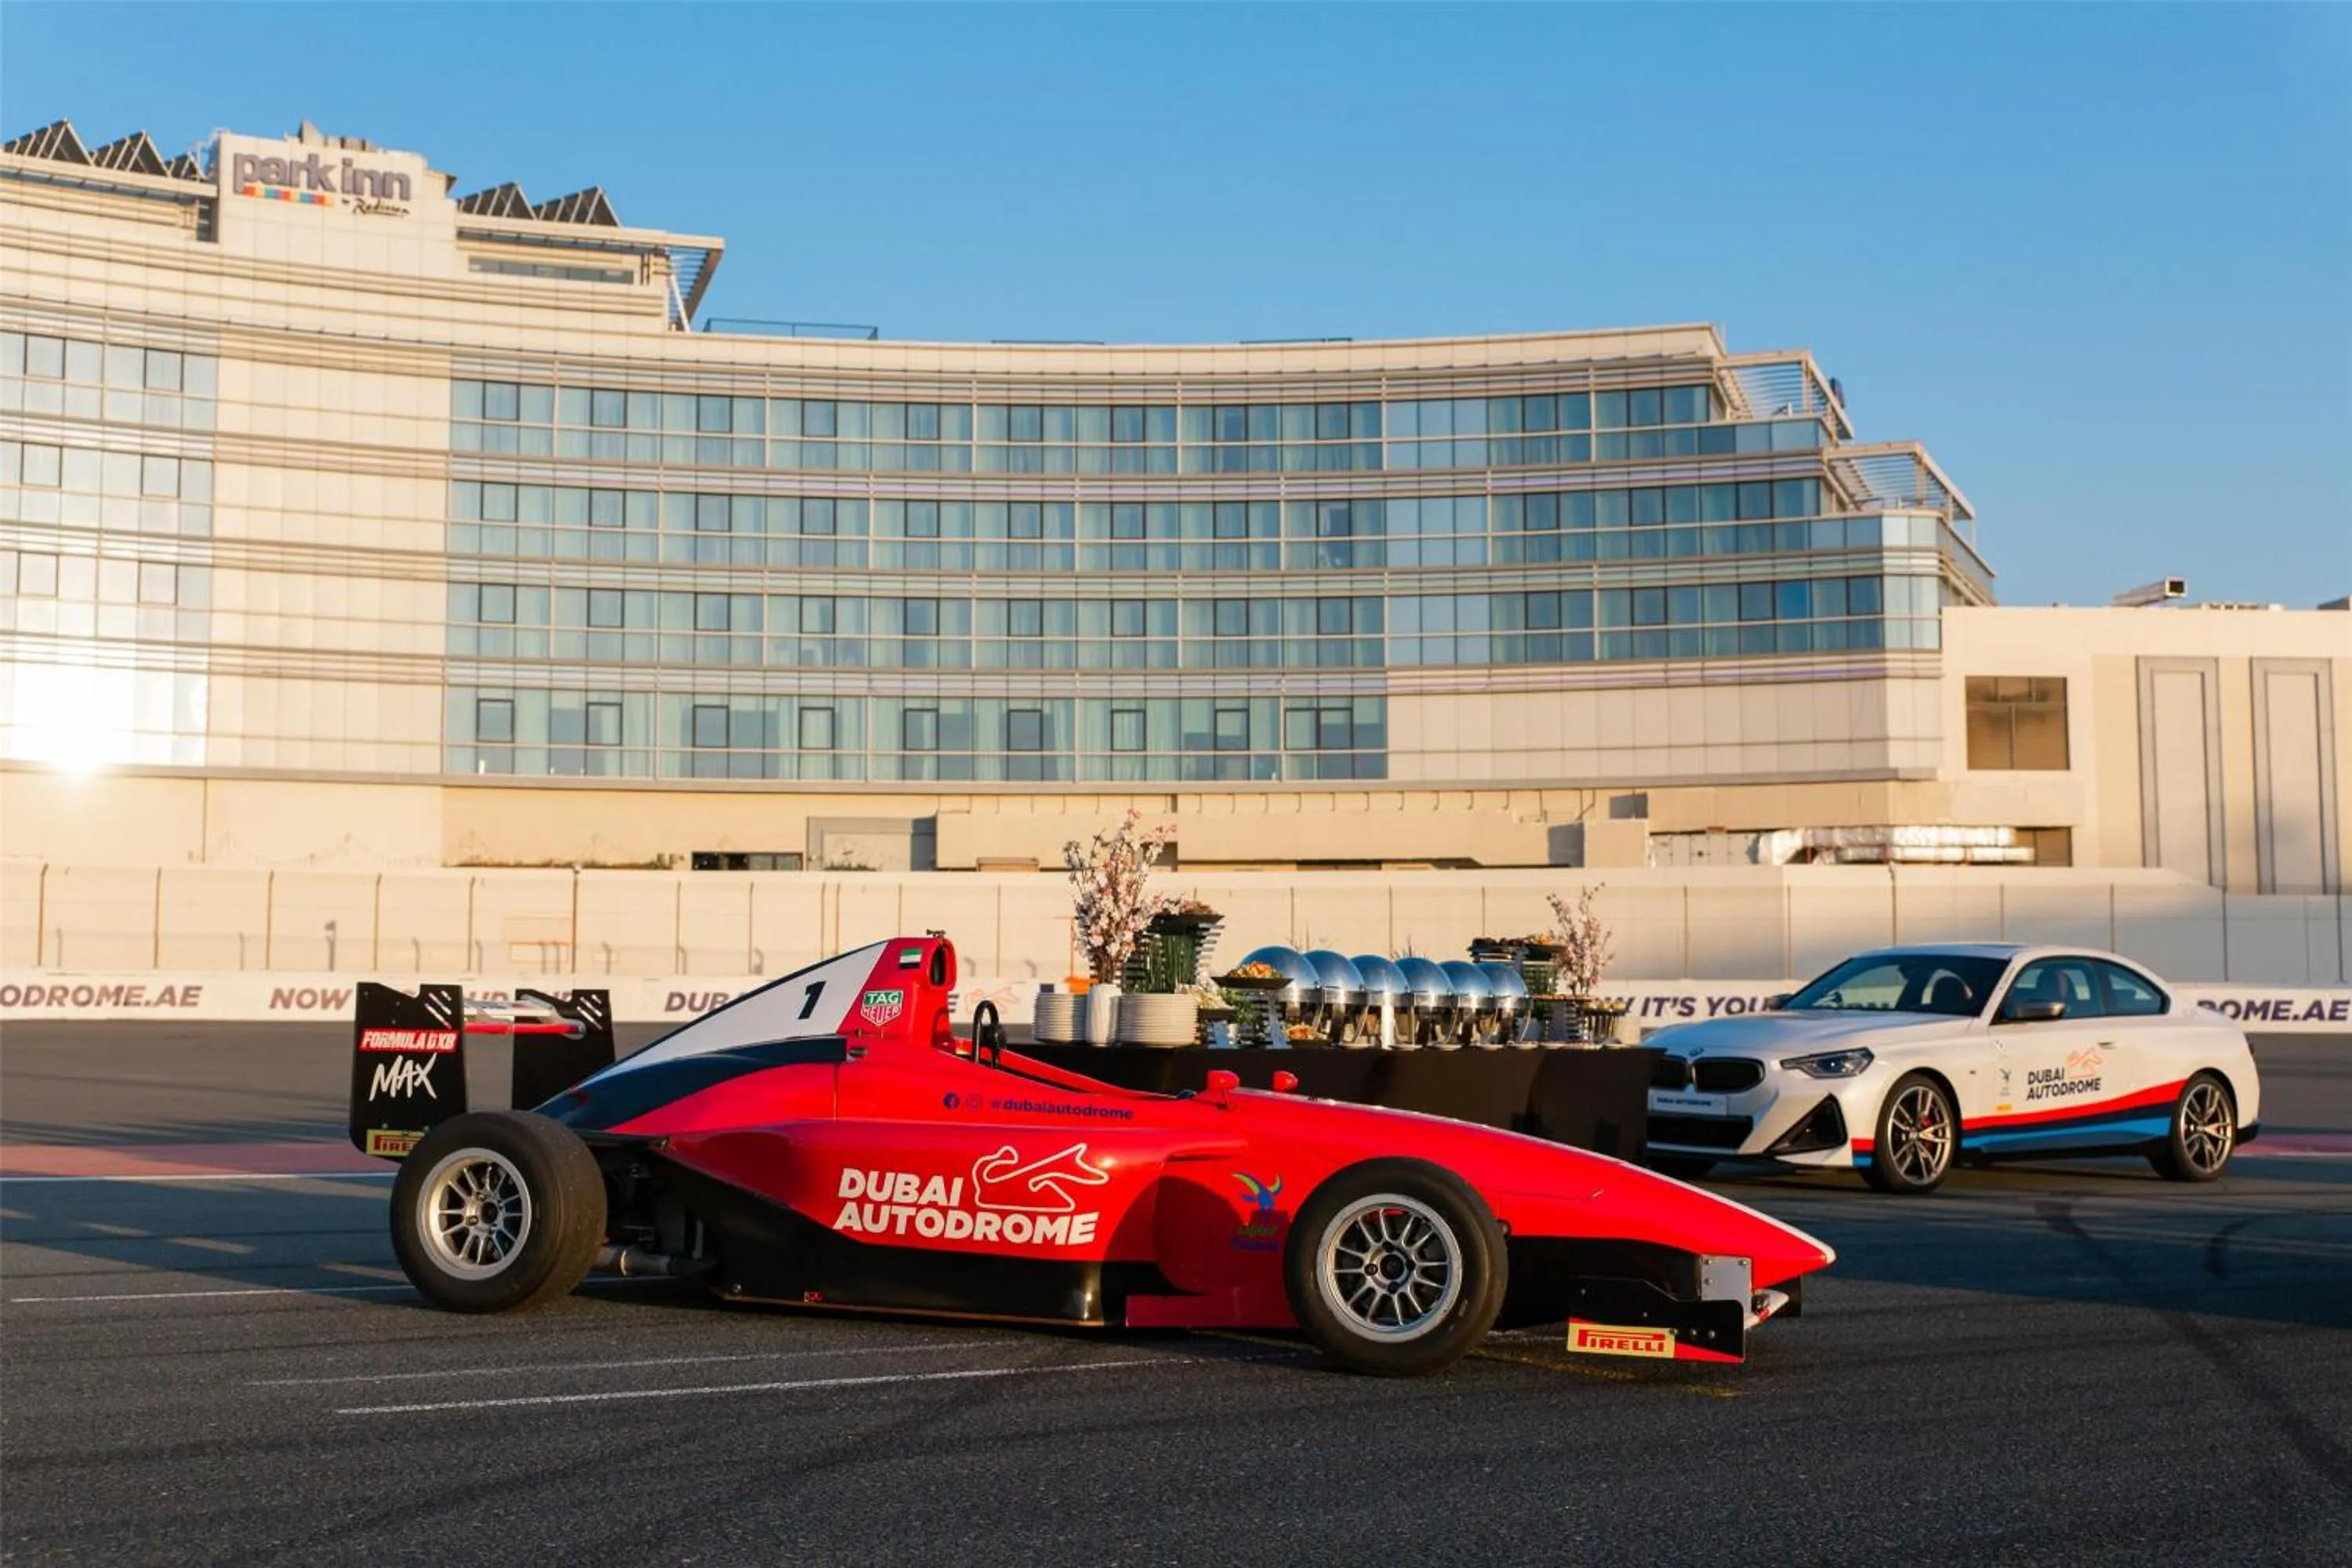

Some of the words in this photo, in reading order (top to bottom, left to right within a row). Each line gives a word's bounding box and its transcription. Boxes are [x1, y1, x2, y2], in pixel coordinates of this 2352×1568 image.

[234, 153, 337, 194] park
[341, 158, 411, 201] inn
[268, 988, 353, 1011] NOW
[665, 991, 745, 1012] DUB
[797, 980, 826, 1020] 1
[866, 992, 900, 1004] TAG
[1640, 996, 1697, 1017] IT'S
[863, 1005, 899, 1023] HEUER
[361, 1031, 426, 1050] FORMULA
[368, 1052, 437, 1102] MAX
[2027, 1067, 2065, 1085] DUBAI
[2026, 1077, 2102, 1102] AUTODROME
[374, 1134, 417, 1152] PIRE
[838, 1168, 964, 1207] DUBAI
[833, 1202, 1099, 1245] AUTODROME
[1577, 1329, 1666, 1352] PIRELLI
